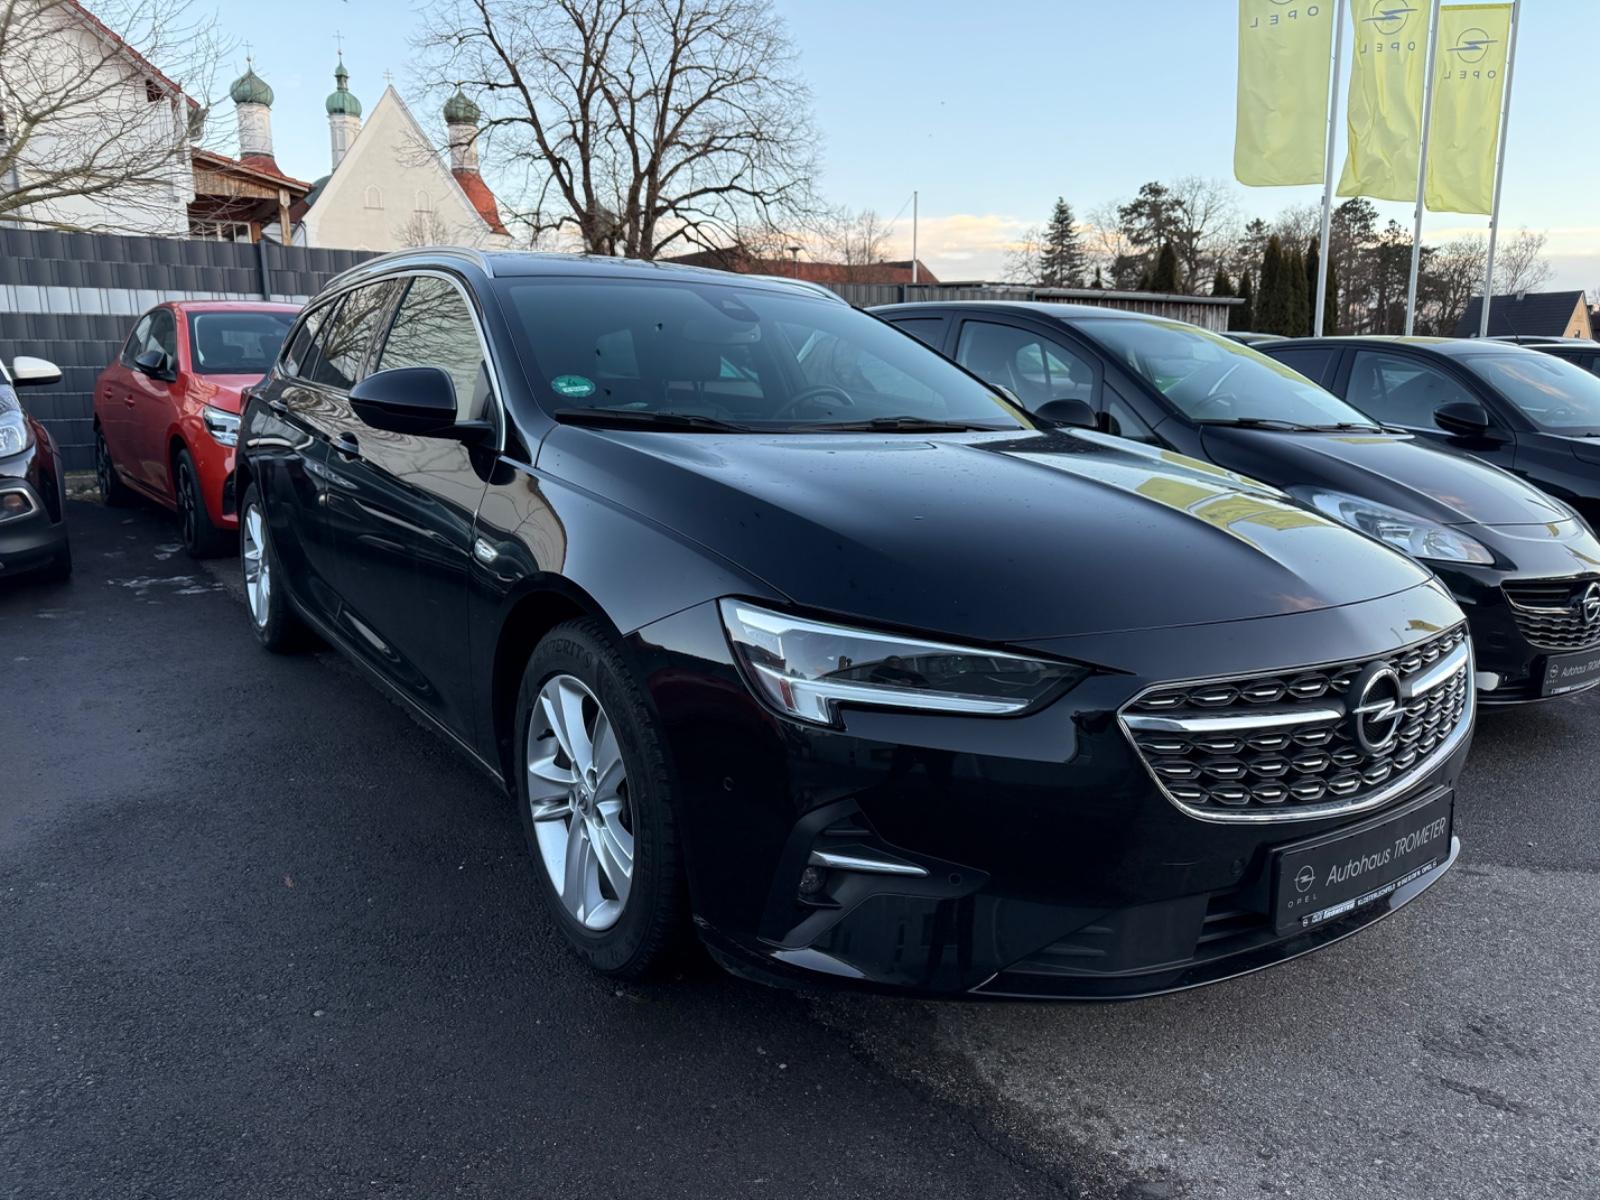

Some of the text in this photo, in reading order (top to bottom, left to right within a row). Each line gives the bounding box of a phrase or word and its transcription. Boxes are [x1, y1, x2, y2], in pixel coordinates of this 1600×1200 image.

[1325, 848, 1391, 887] Autohaus
[1393, 816, 1447, 859] TROMETER
[1287, 893, 1318, 908] OPEL
